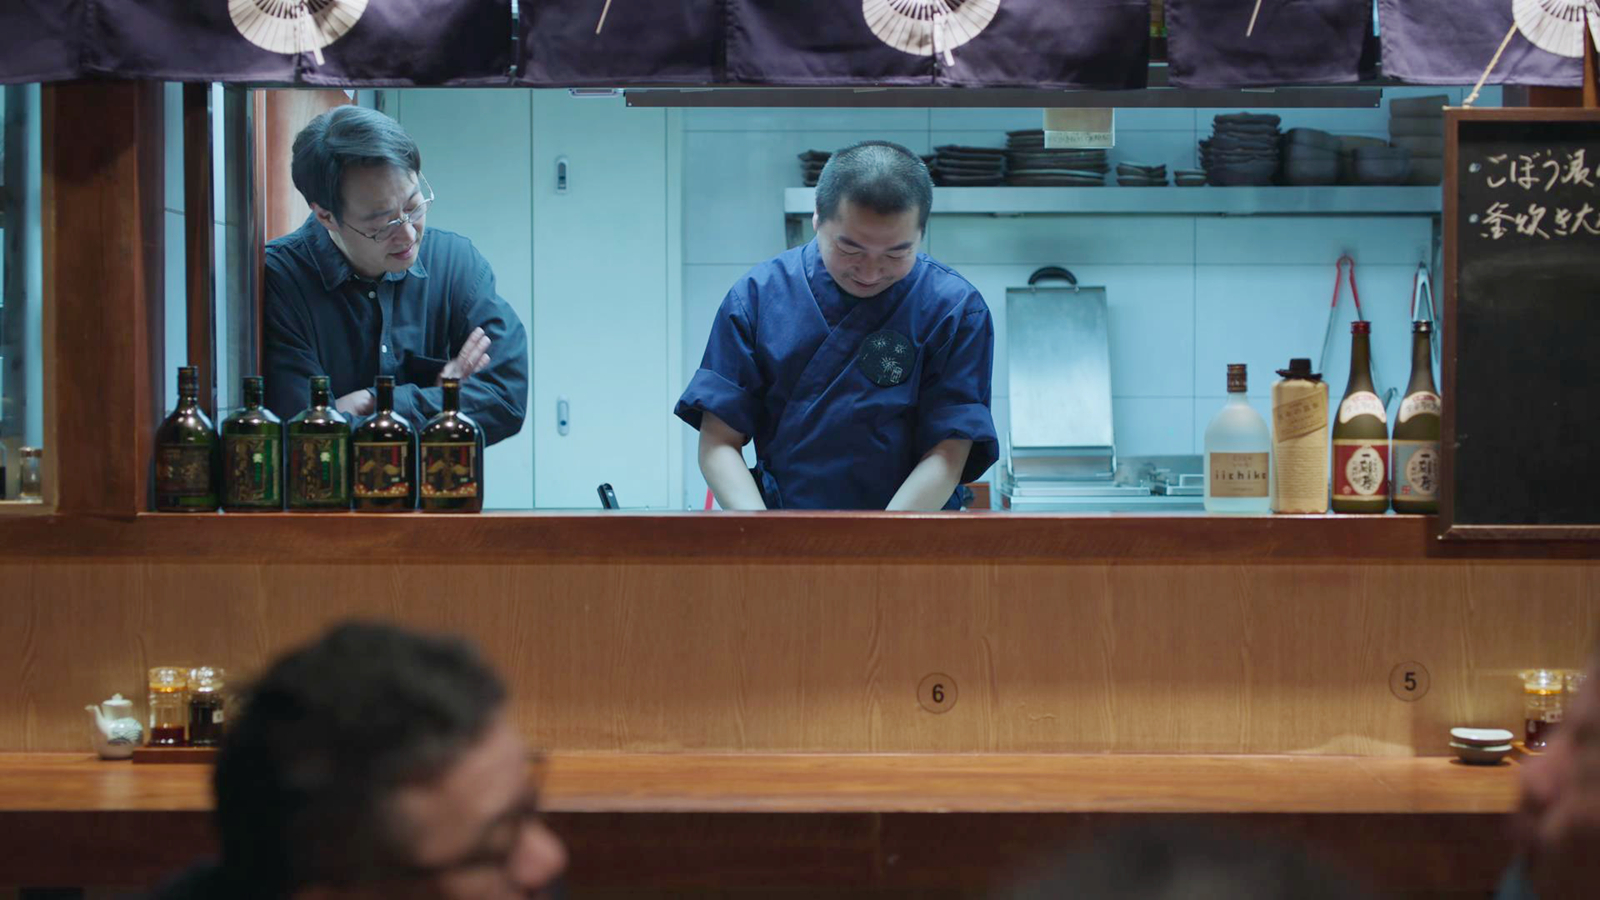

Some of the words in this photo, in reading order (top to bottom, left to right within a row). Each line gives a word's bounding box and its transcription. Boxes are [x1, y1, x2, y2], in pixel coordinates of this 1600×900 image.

[1214, 469, 1267, 481] iichiko
[1404, 671, 1417, 692] 5
[932, 682, 945, 704] 6
